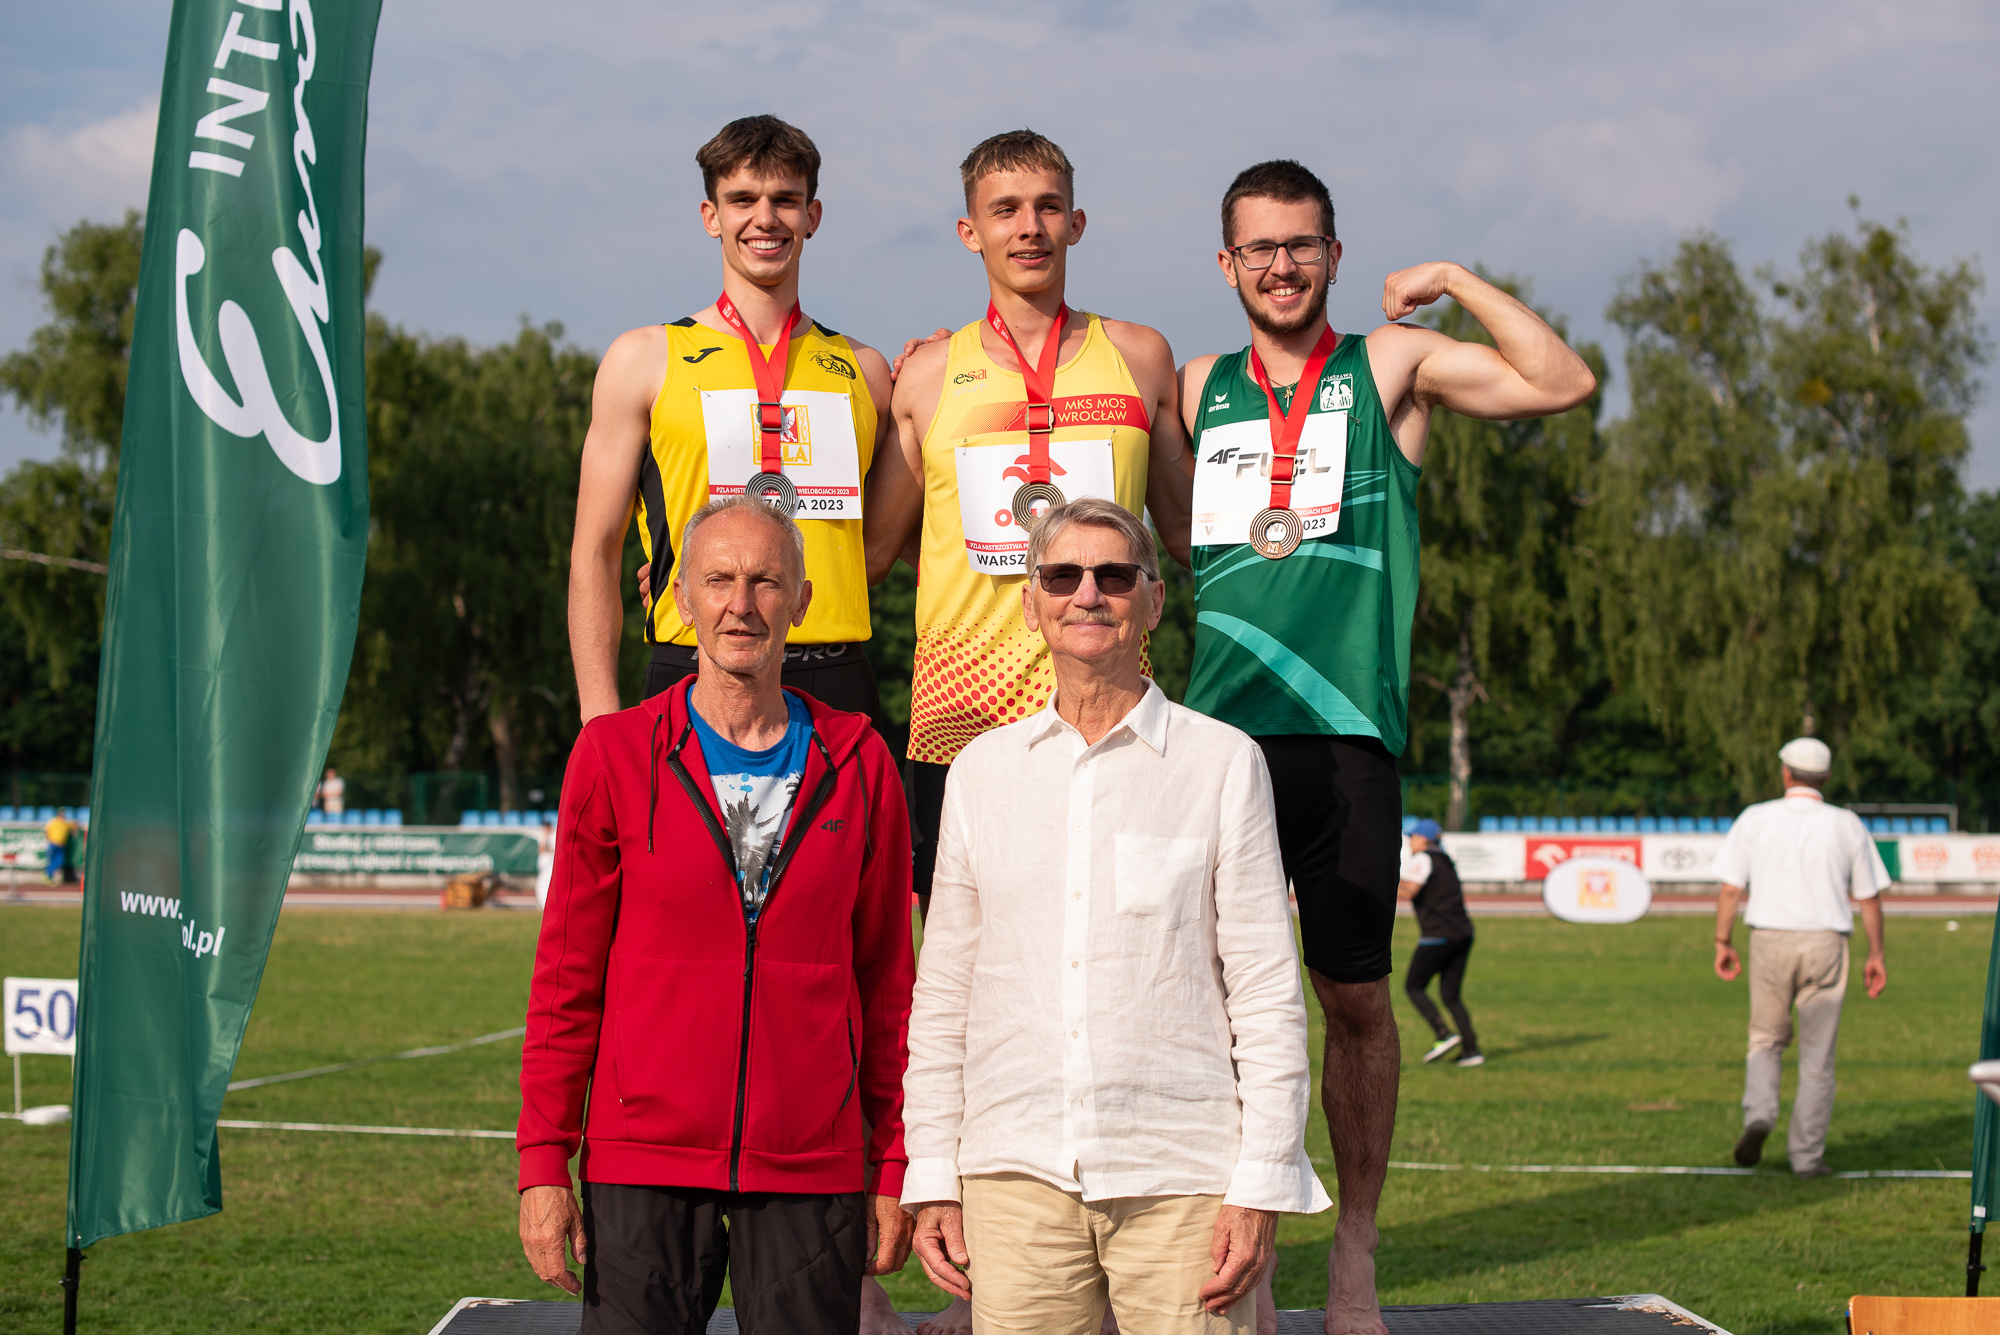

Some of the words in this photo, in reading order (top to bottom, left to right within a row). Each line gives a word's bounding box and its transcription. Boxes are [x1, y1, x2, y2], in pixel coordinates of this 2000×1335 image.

[821, 359, 850, 375] OSA
[1065, 398, 1093, 410] MKS
[1097, 397, 1126, 409] MOS
[1058, 410, 1127, 423] WROCŁAW
[1207, 447, 1240, 464] 4F
[810, 500, 843, 511] 2023
[1303, 518, 1326, 531] 023
[982, 543, 1022, 551] MISTRZOSTWA
[976, 554, 1027, 567] WARSZ
[821, 819, 845, 833] 4F
[15, 988, 75, 1041] 50
